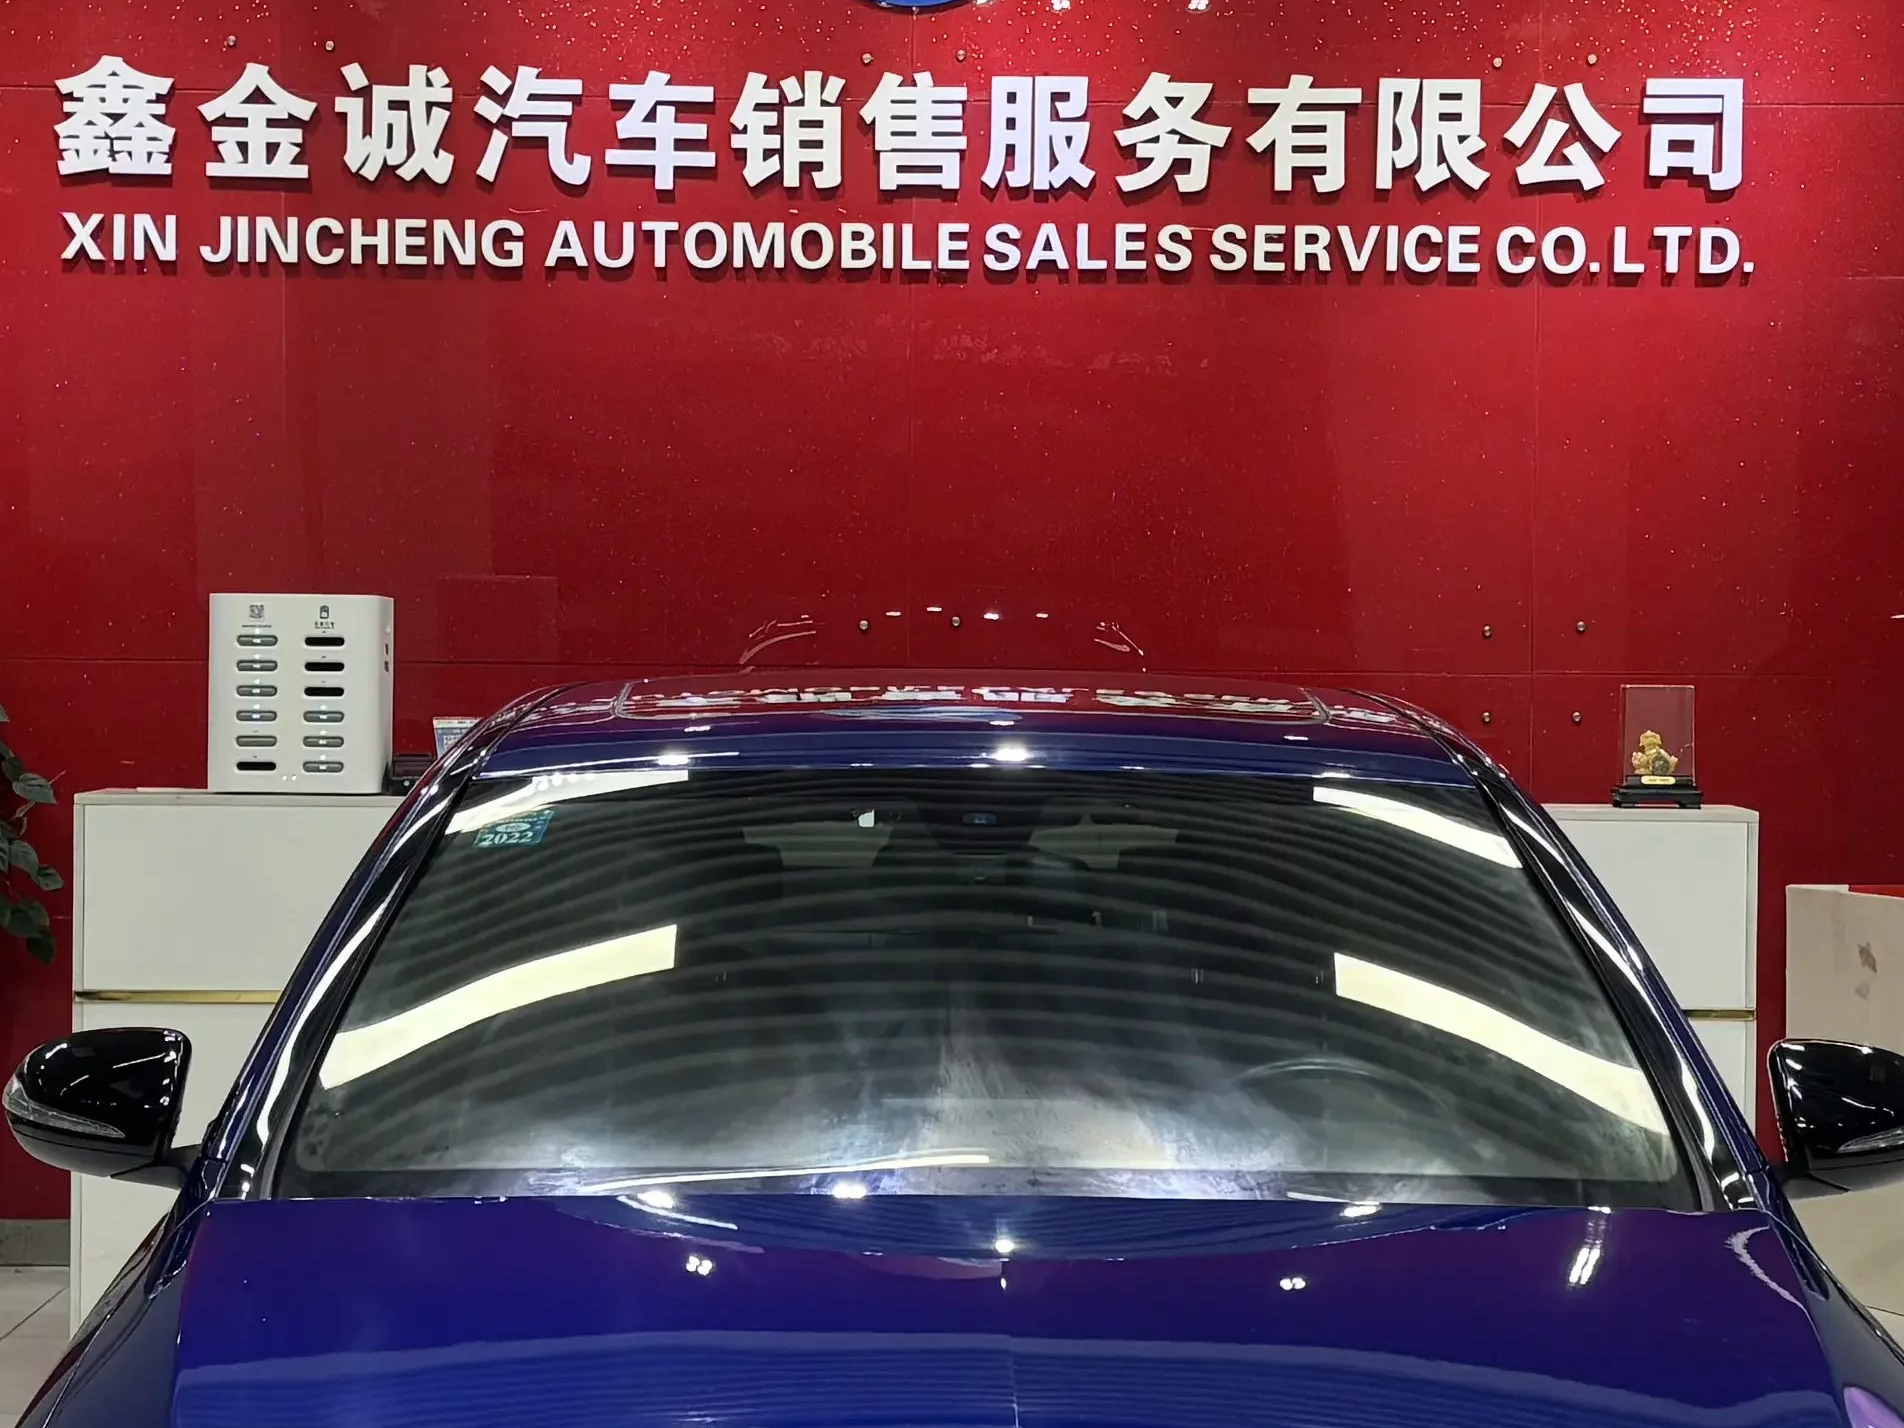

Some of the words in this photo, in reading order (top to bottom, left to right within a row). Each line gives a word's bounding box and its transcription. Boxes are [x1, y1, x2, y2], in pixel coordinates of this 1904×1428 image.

[55, 55, 1744, 193] 鑫金诚汽车销售服务有限公司
[61, 213, 177, 263] XIN
[199, 216, 526, 268] JINCHENG
[544, 219, 970, 272] AUTOMOBILE
[984, 223, 1192, 274] SALES
[1209, 224, 1482, 274] SERVICE
[481, 831, 533, 846] 2022
